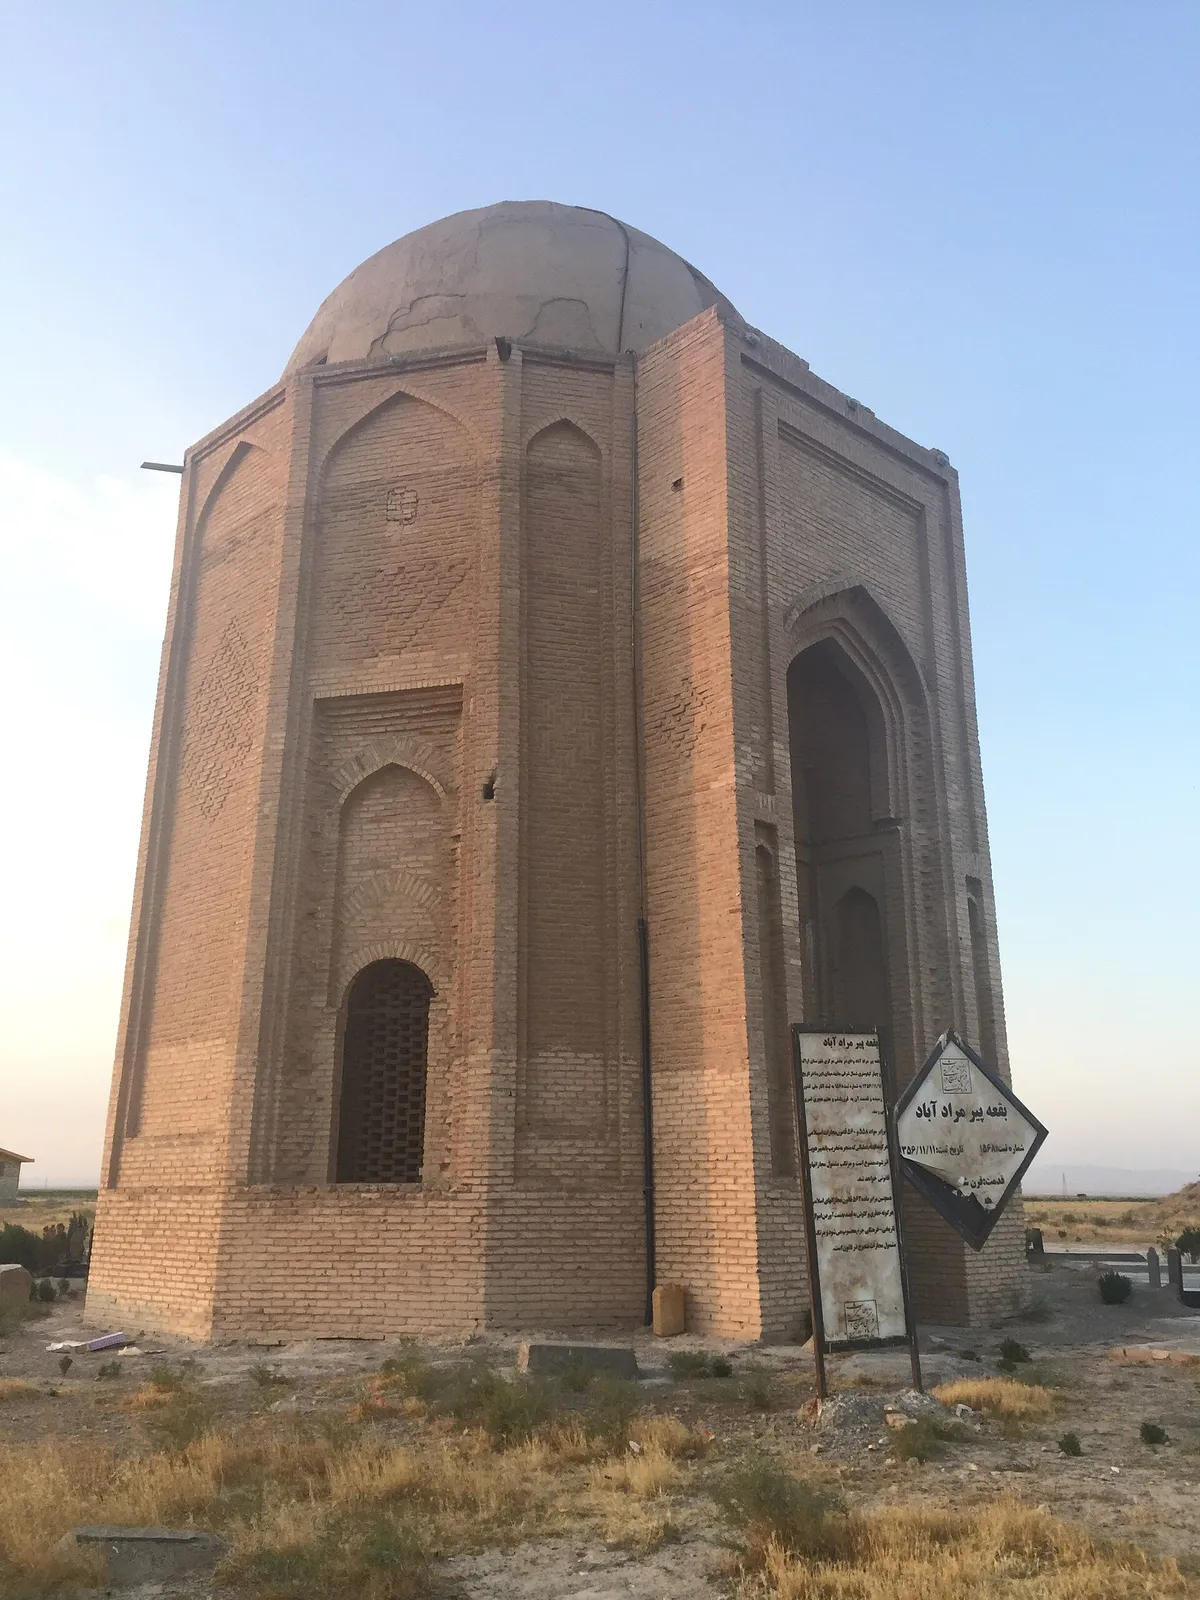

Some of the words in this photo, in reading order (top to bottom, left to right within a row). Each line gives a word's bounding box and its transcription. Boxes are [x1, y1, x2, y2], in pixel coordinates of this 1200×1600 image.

[823, 1037, 836, 1048] آباد
[838, 1038, 853, 1049] مراد
[855, 1039, 864, 1049] پیر
[915, 1101, 937, 1122] آباد
[941, 1102, 965, 1123] مراد
[969, 1106, 984, 1123] پیر
[986, 1102, 1007, 1121] بقعه
[949, 1144, 964, 1156] تاریخ
[1008, 1144, 1024, 1154] شماره
